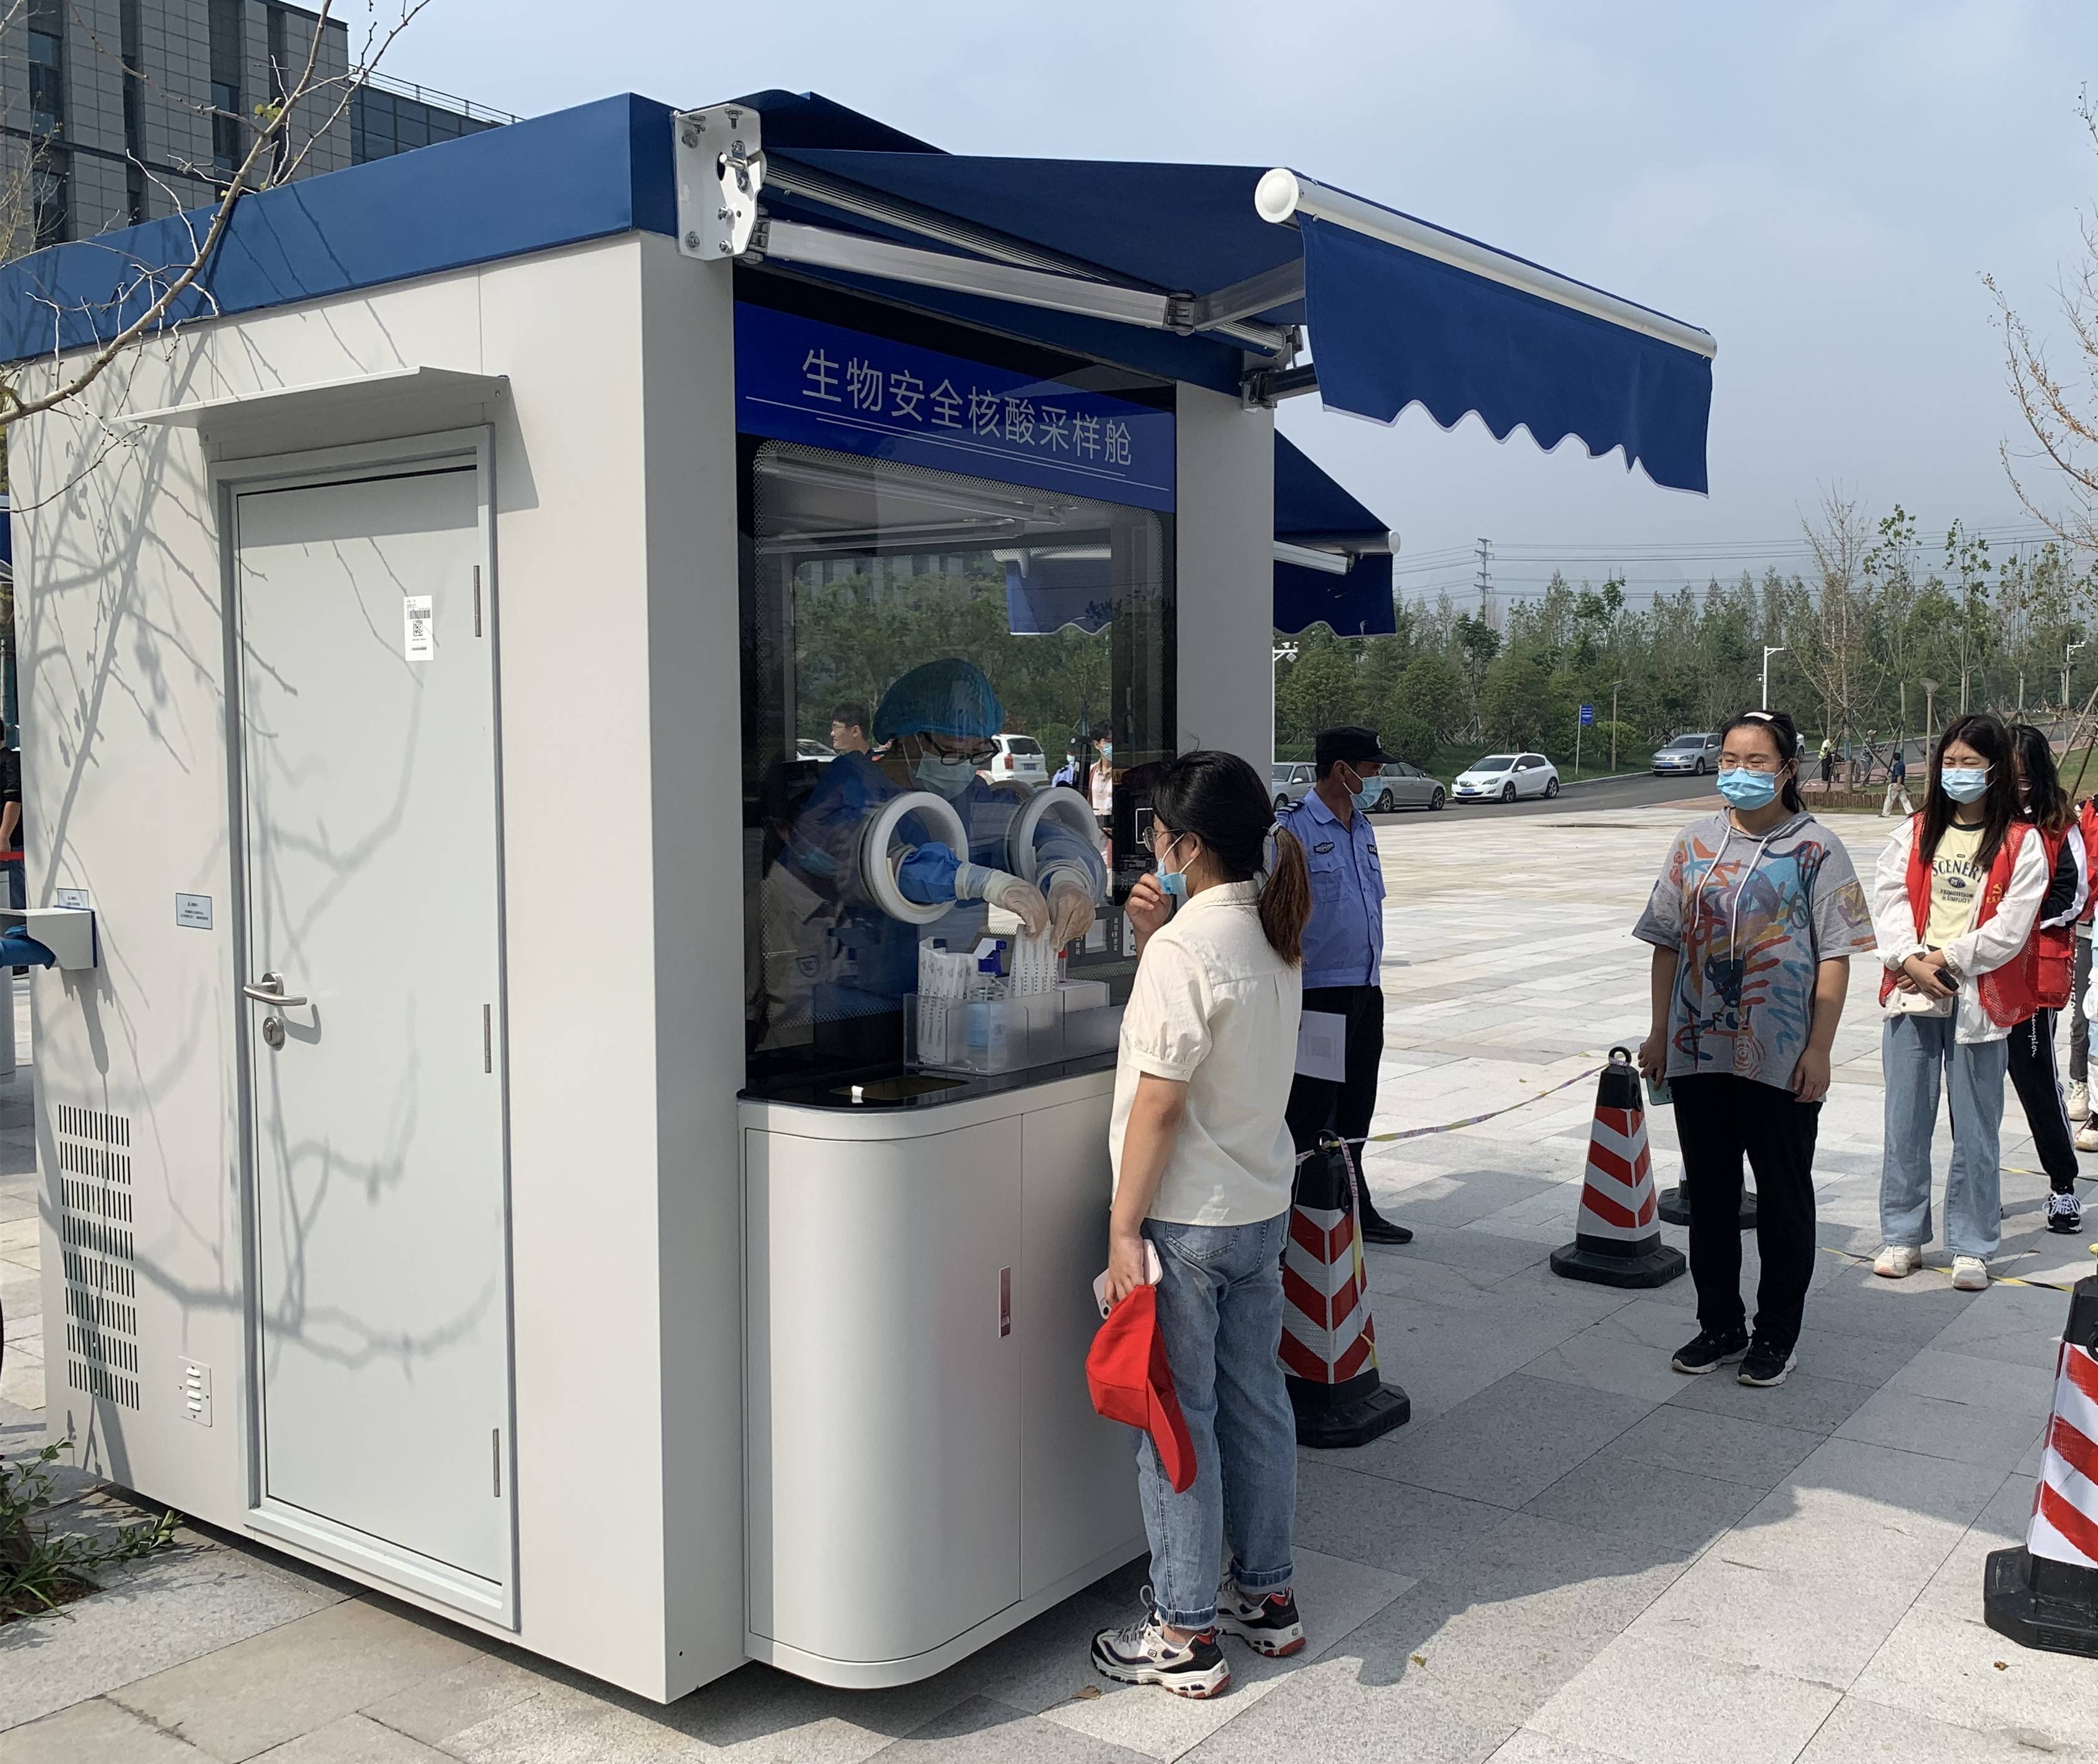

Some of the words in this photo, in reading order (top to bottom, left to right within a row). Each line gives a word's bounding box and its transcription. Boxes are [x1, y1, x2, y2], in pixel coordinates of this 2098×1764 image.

[801, 348, 1133, 465] 生物安全核酸采样舱
